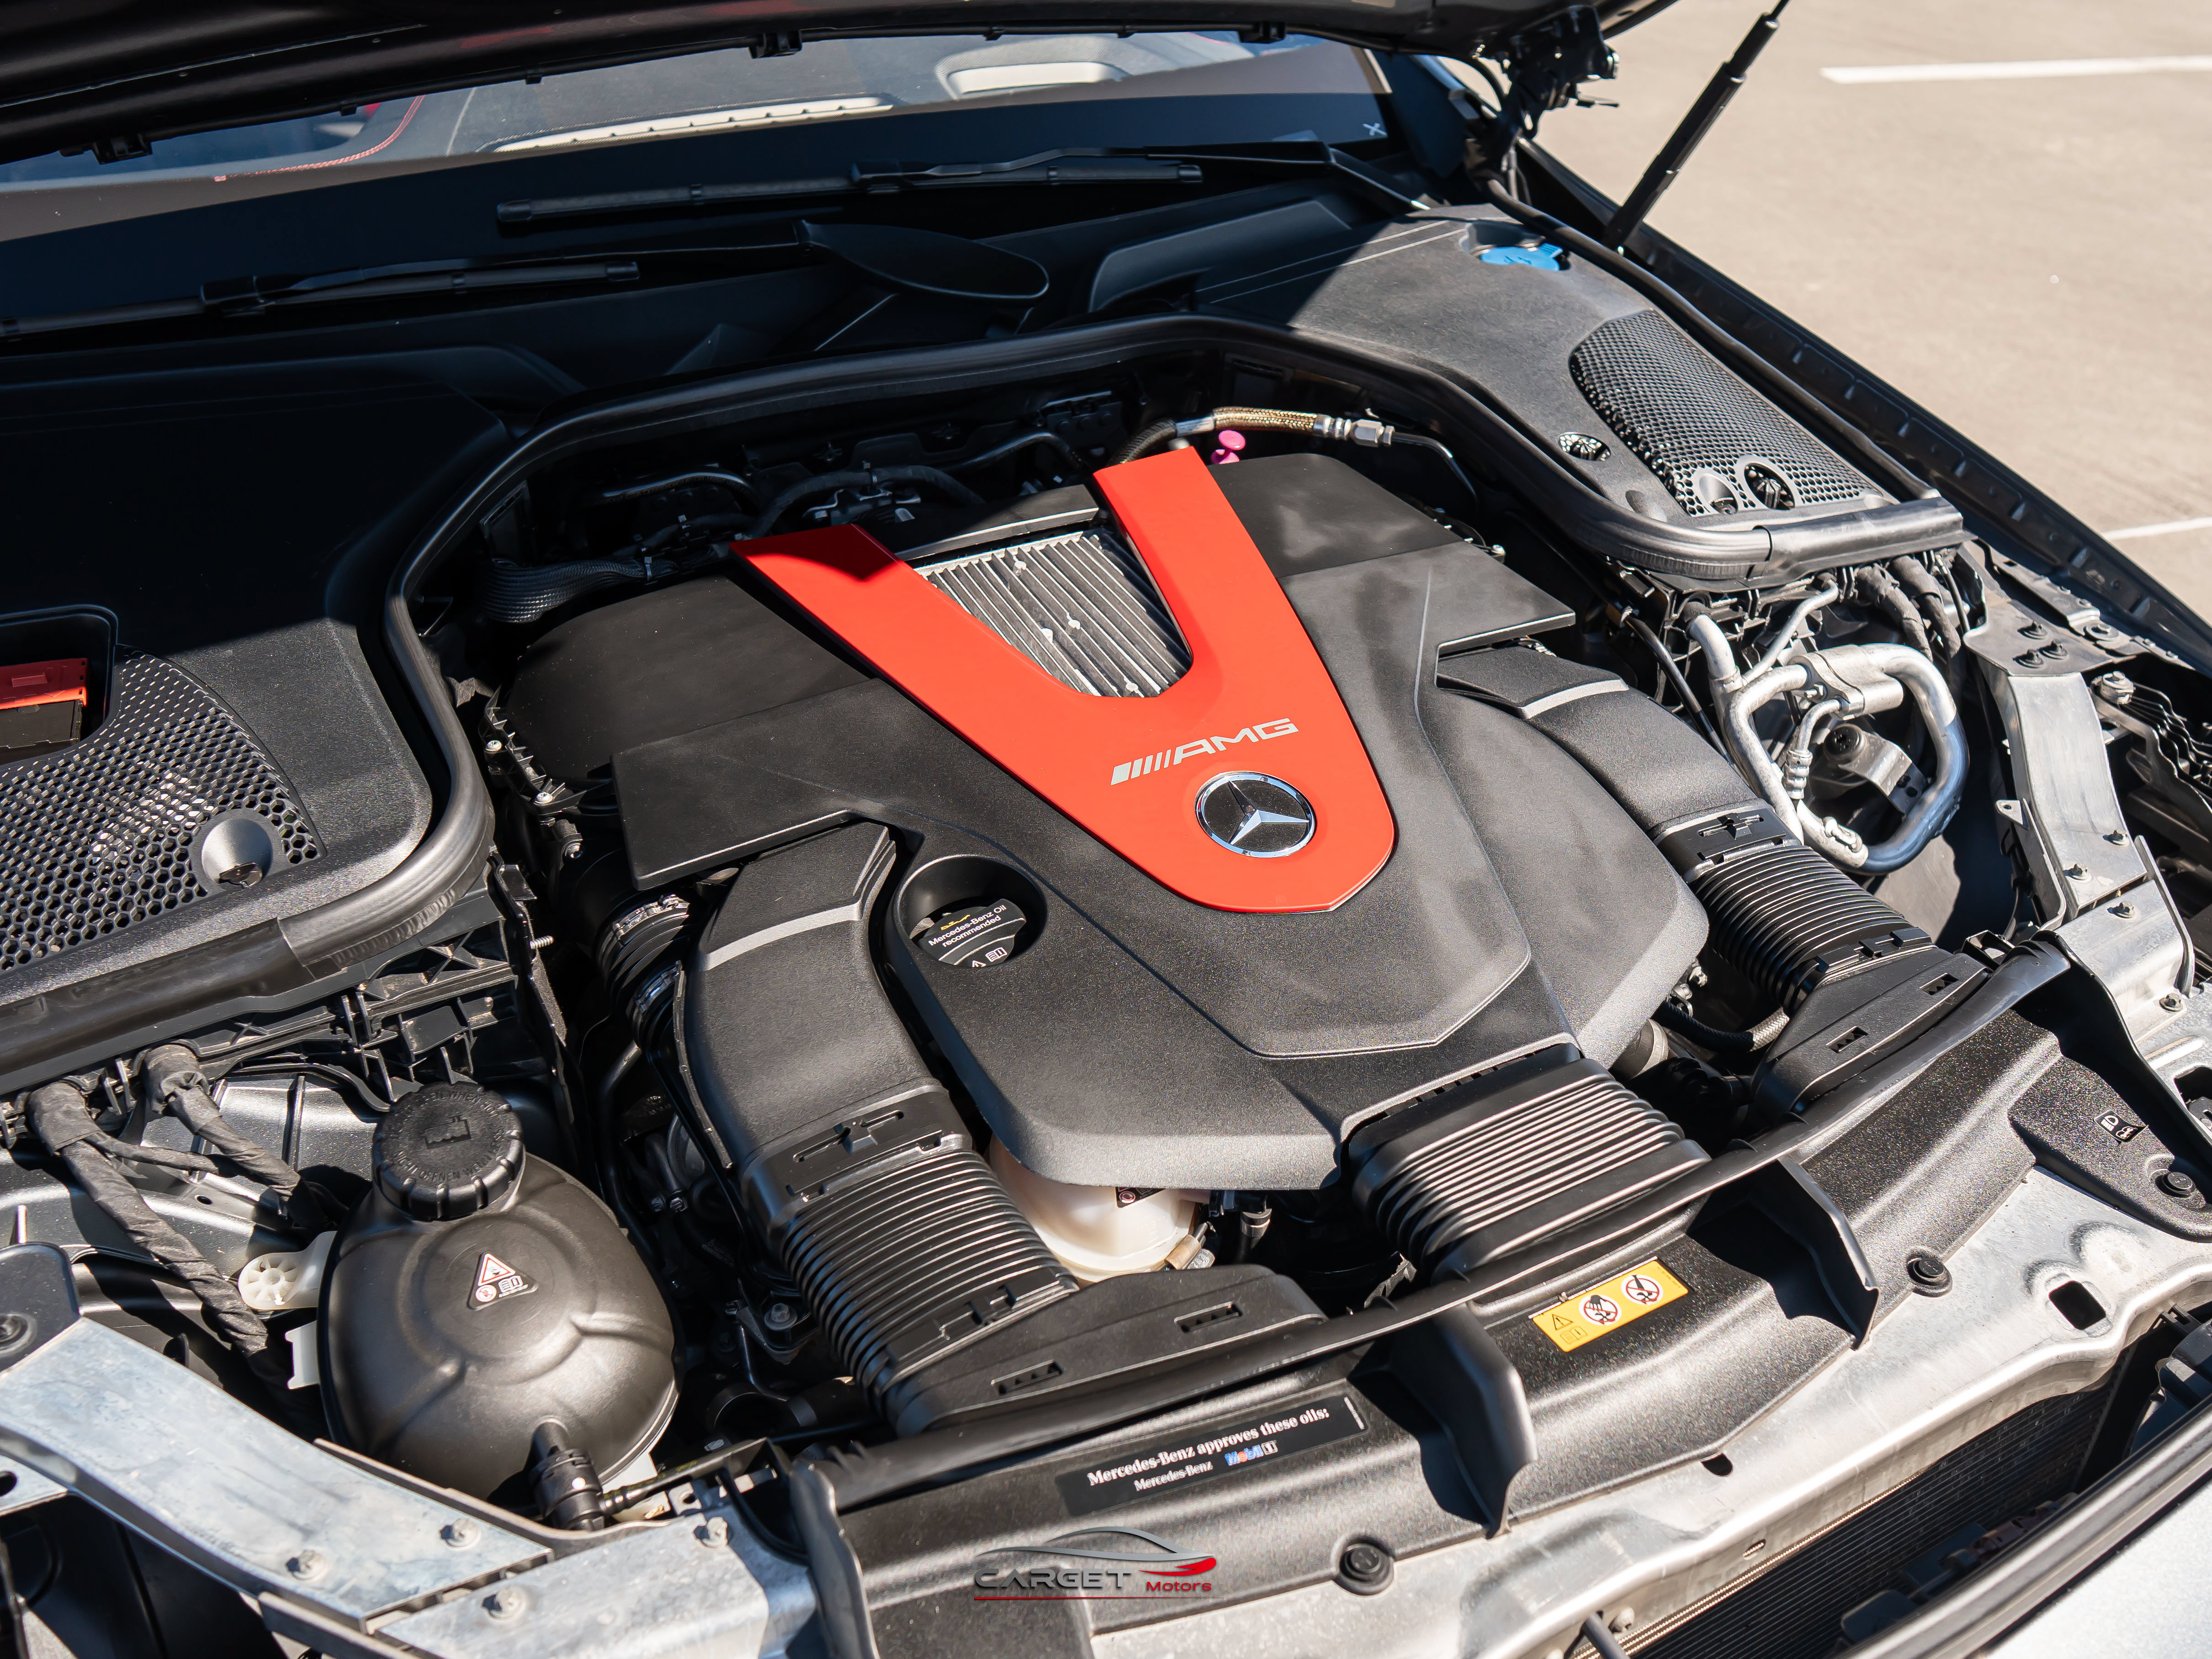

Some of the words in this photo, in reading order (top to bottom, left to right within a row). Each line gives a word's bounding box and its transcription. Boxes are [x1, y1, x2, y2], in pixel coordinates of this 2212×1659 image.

[928, 912, 994, 946] Mercedes-Benz
[993, 905, 1007, 913] Oil
[942, 915, 1002, 947] recommended
[1087, 1446, 1196, 1486] Mercedes-Benz
[1196, 1428, 1260, 1455] approves
[1259, 1417, 1299, 1436] these
[1299, 1408, 1330, 1425] oils:
[1133, 1461, 1214, 1492] Mercedes-Benz
